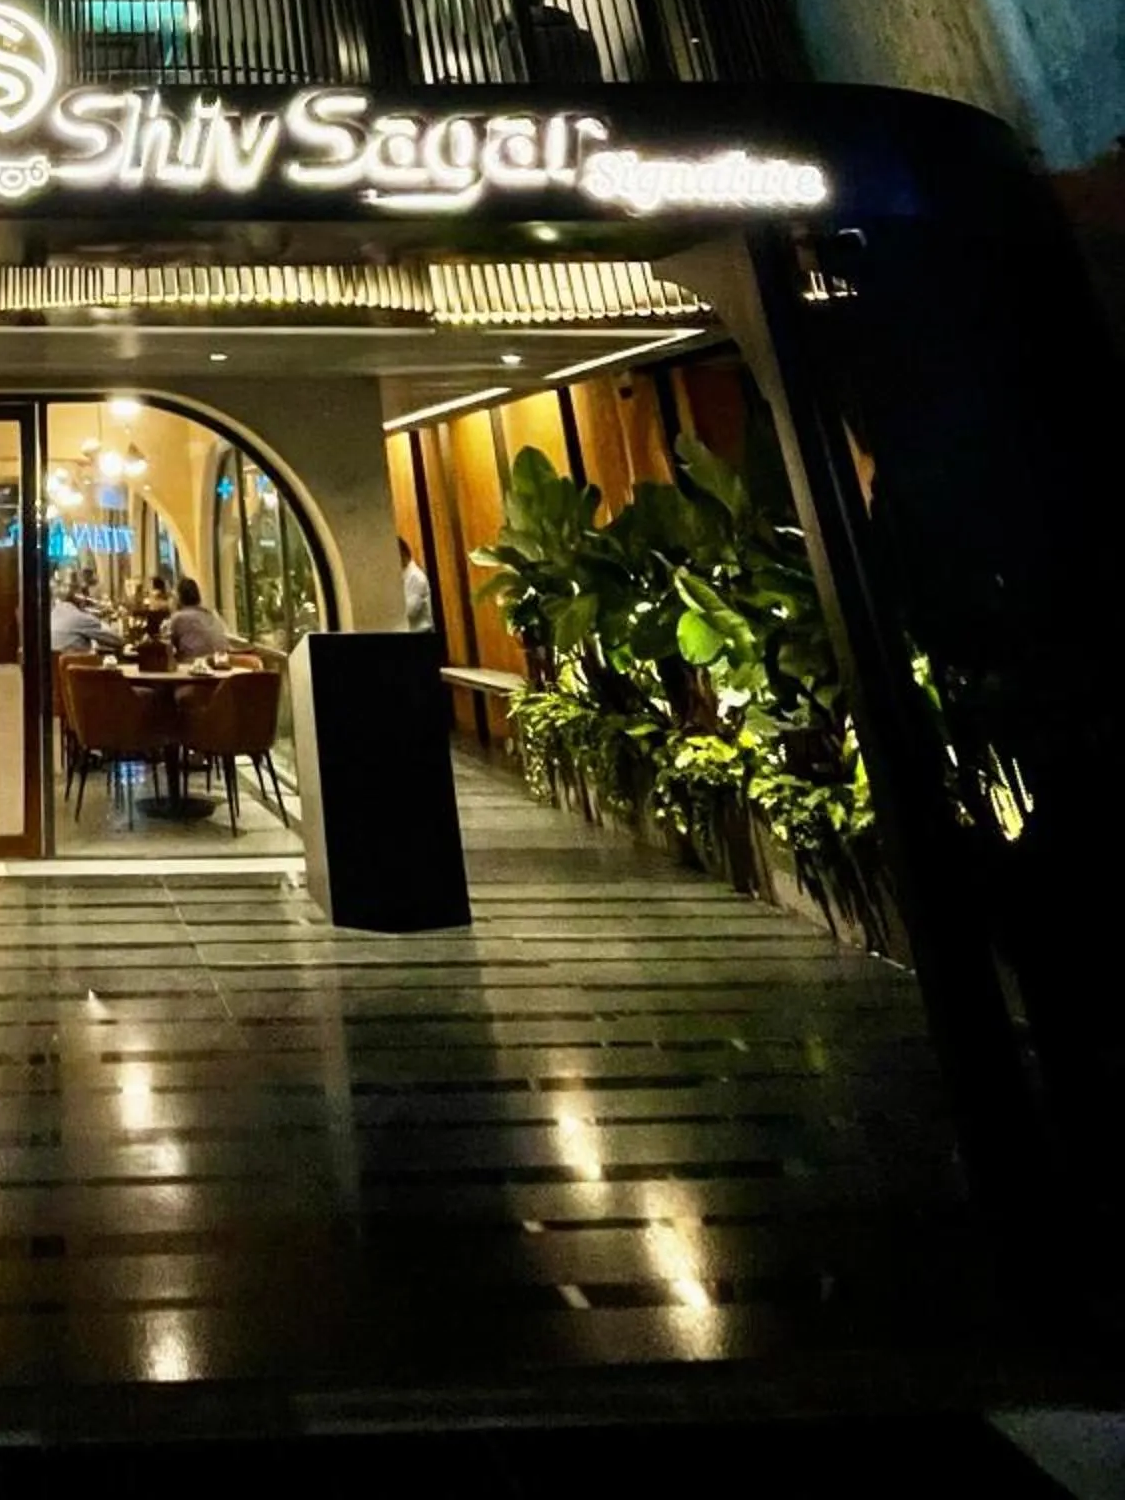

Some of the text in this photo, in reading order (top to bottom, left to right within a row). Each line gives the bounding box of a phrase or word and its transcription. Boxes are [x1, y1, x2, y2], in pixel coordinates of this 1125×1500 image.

[51, 87, 609, 210] Shiv Sagar
[584, 151, 828, 213] Signature
